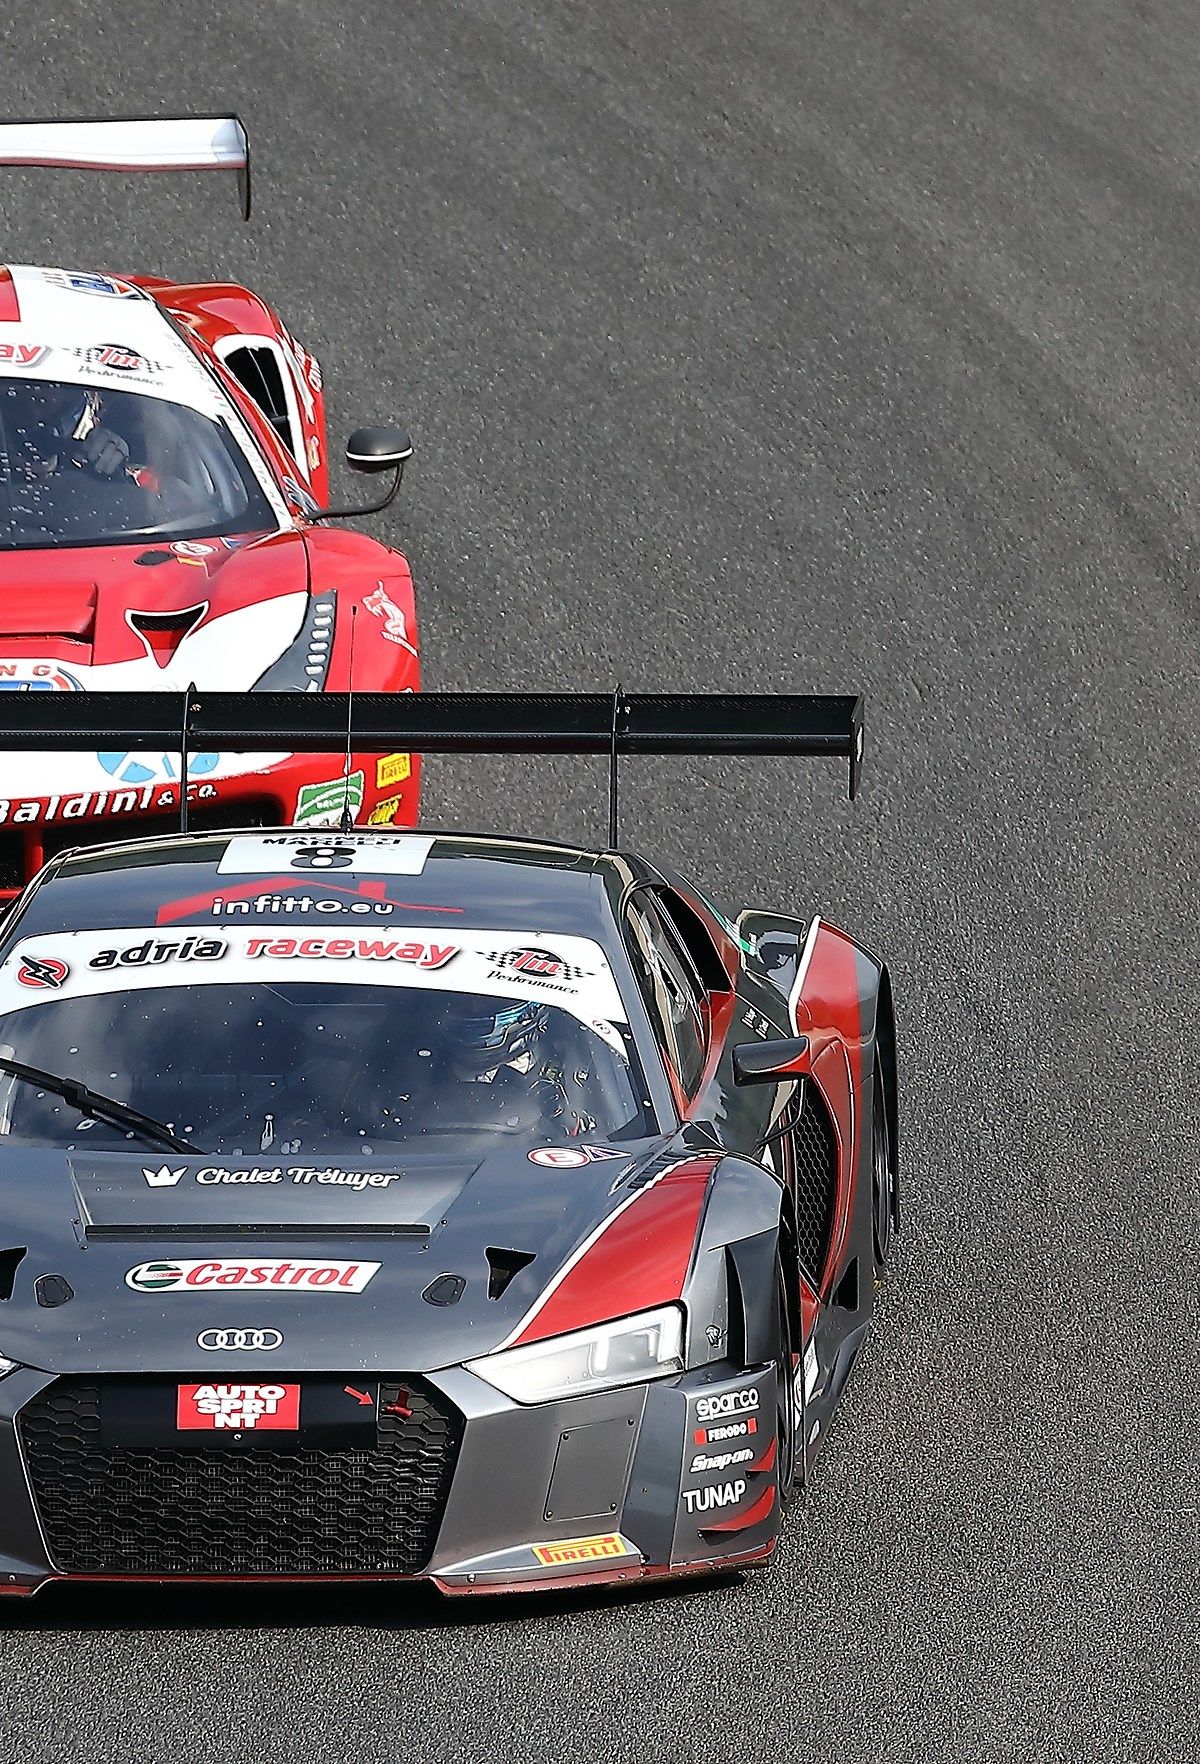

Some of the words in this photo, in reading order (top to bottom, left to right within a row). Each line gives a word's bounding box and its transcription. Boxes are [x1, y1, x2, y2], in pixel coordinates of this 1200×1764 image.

[157, 790, 174, 806] &
[290, 847, 357, 869] 8
[211, 894, 395, 916] infitto.eu
[89, 936, 224, 968] adria
[246, 938, 456, 967] raceway
[486, 970, 580, 995] Performance
[196, 1167, 283, 1185] Chalet
[287, 1167, 400, 1191] Tréluyer
[185, 1262, 361, 1288] Castrol
[192, 1385, 287, 1400] AUTO
[696, 1387, 759, 1420] sparco
[196, 1399, 278, 1415] SPRI
[213, 1413, 262, 1428] NT
[707, 1423, 747, 1442] FERODO
[690, 1448, 751, 1474] Snap-on
[682, 1479, 747, 1514] TUNAP
[538, 1536, 620, 1563] PIRELLI
